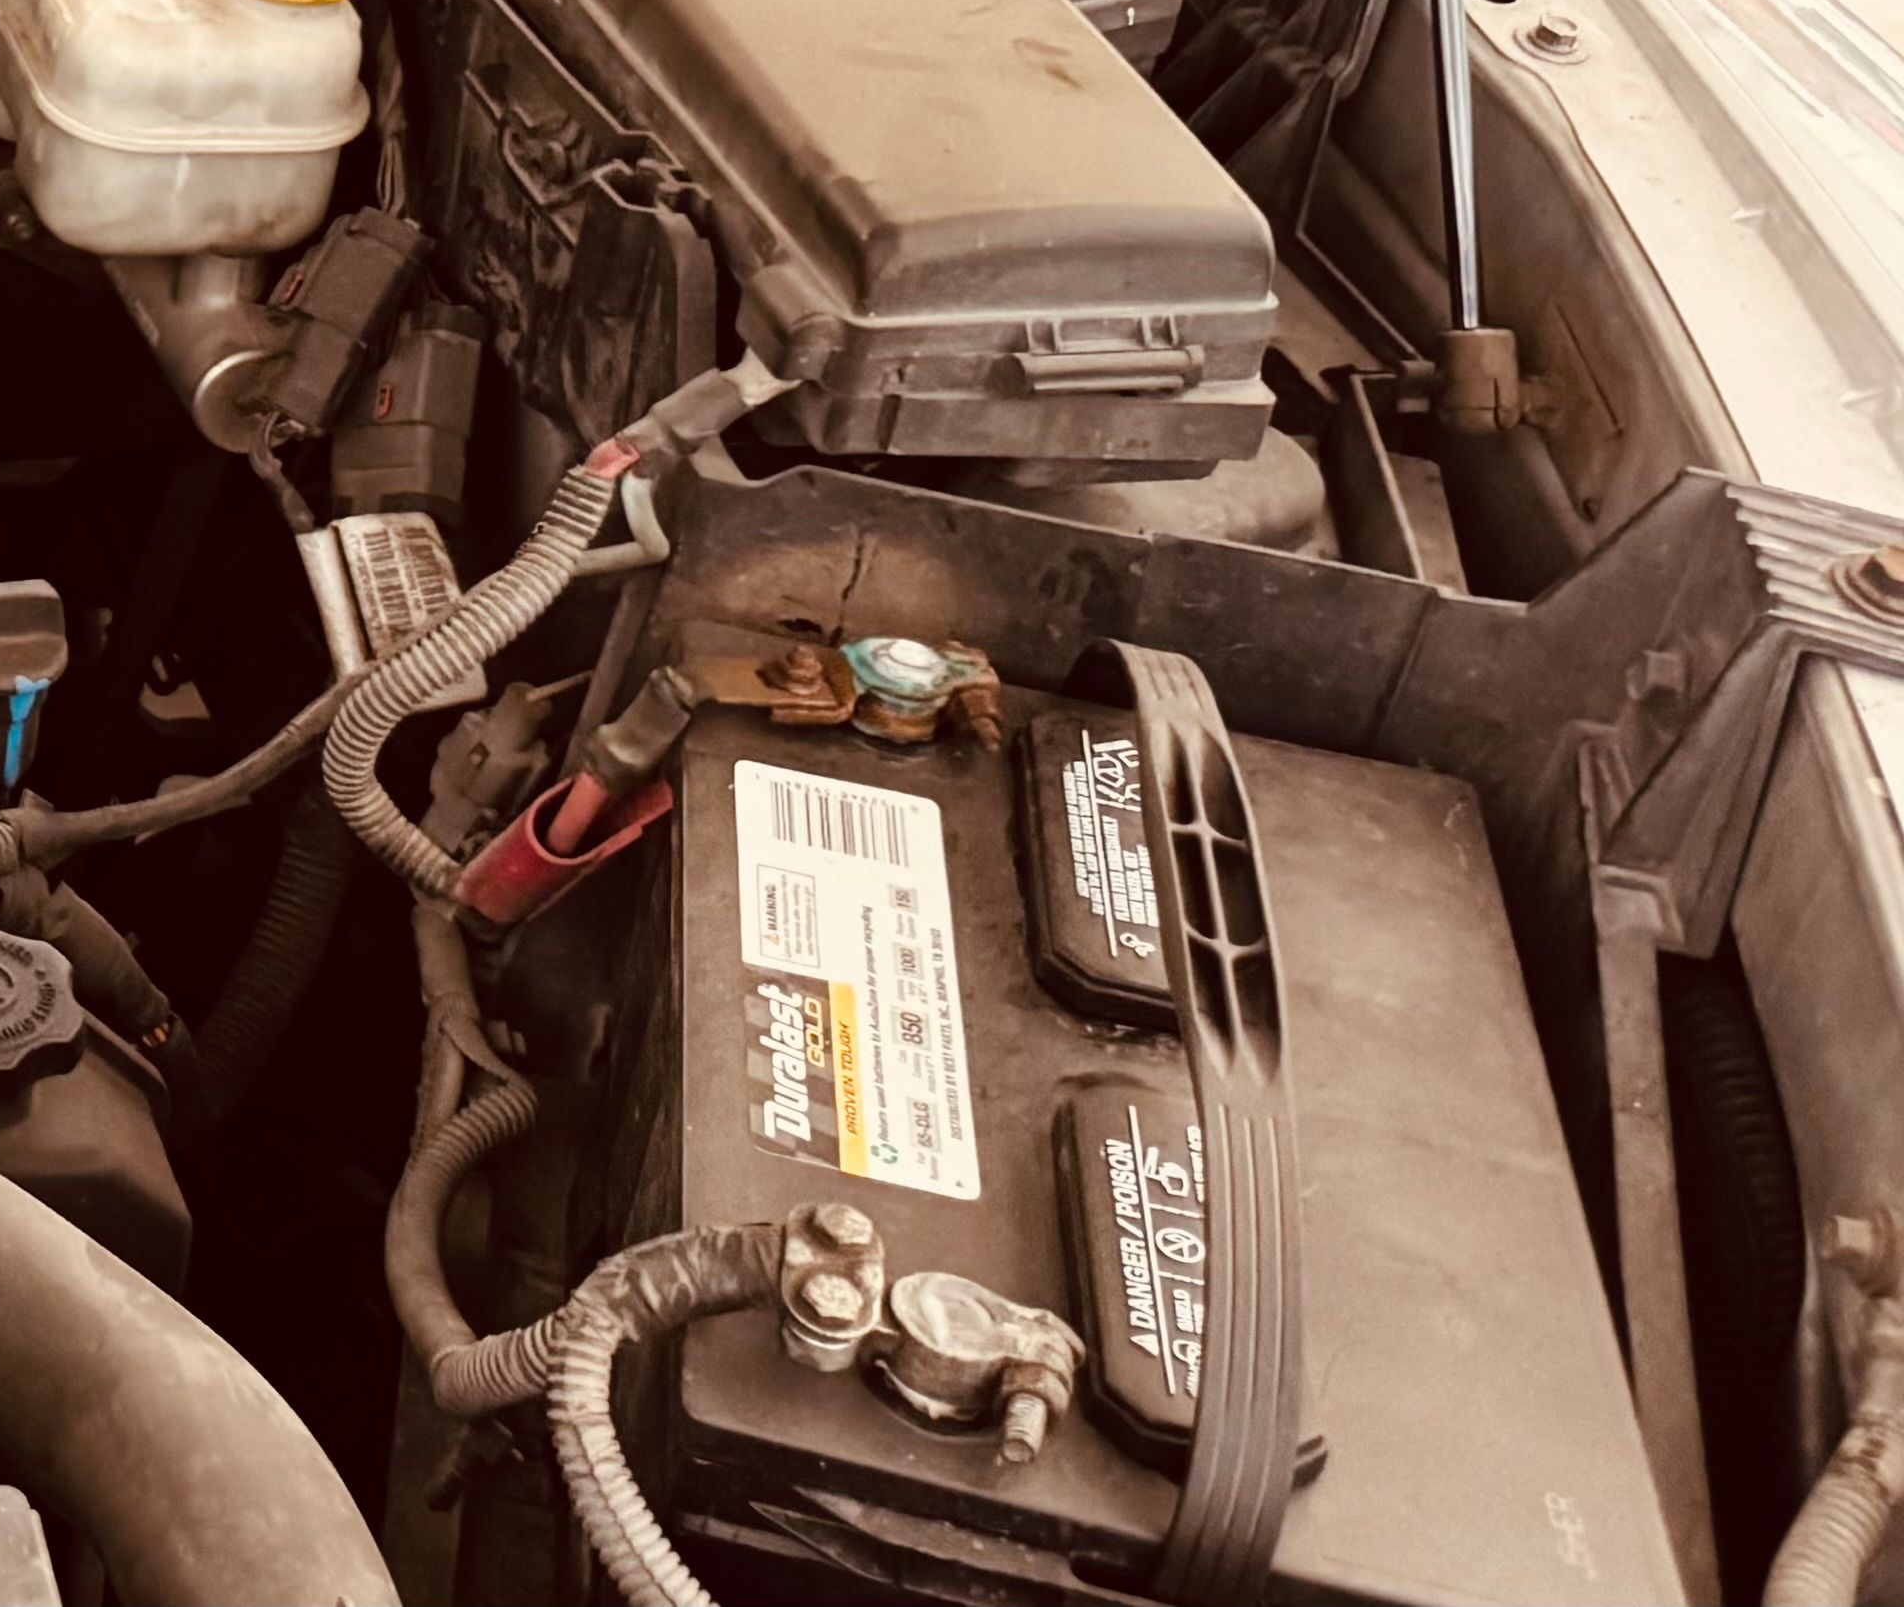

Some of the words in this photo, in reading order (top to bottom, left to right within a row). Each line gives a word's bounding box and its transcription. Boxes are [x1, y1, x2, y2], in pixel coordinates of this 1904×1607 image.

[804, 996, 825, 1068] GOLD
[838, 1020, 853, 1071] TOUGH
[899, 1011, 924, 1045] 850
[756, 983, 812, 1142] Duralast
[842, 1075, 859, 1135] PROVEN
